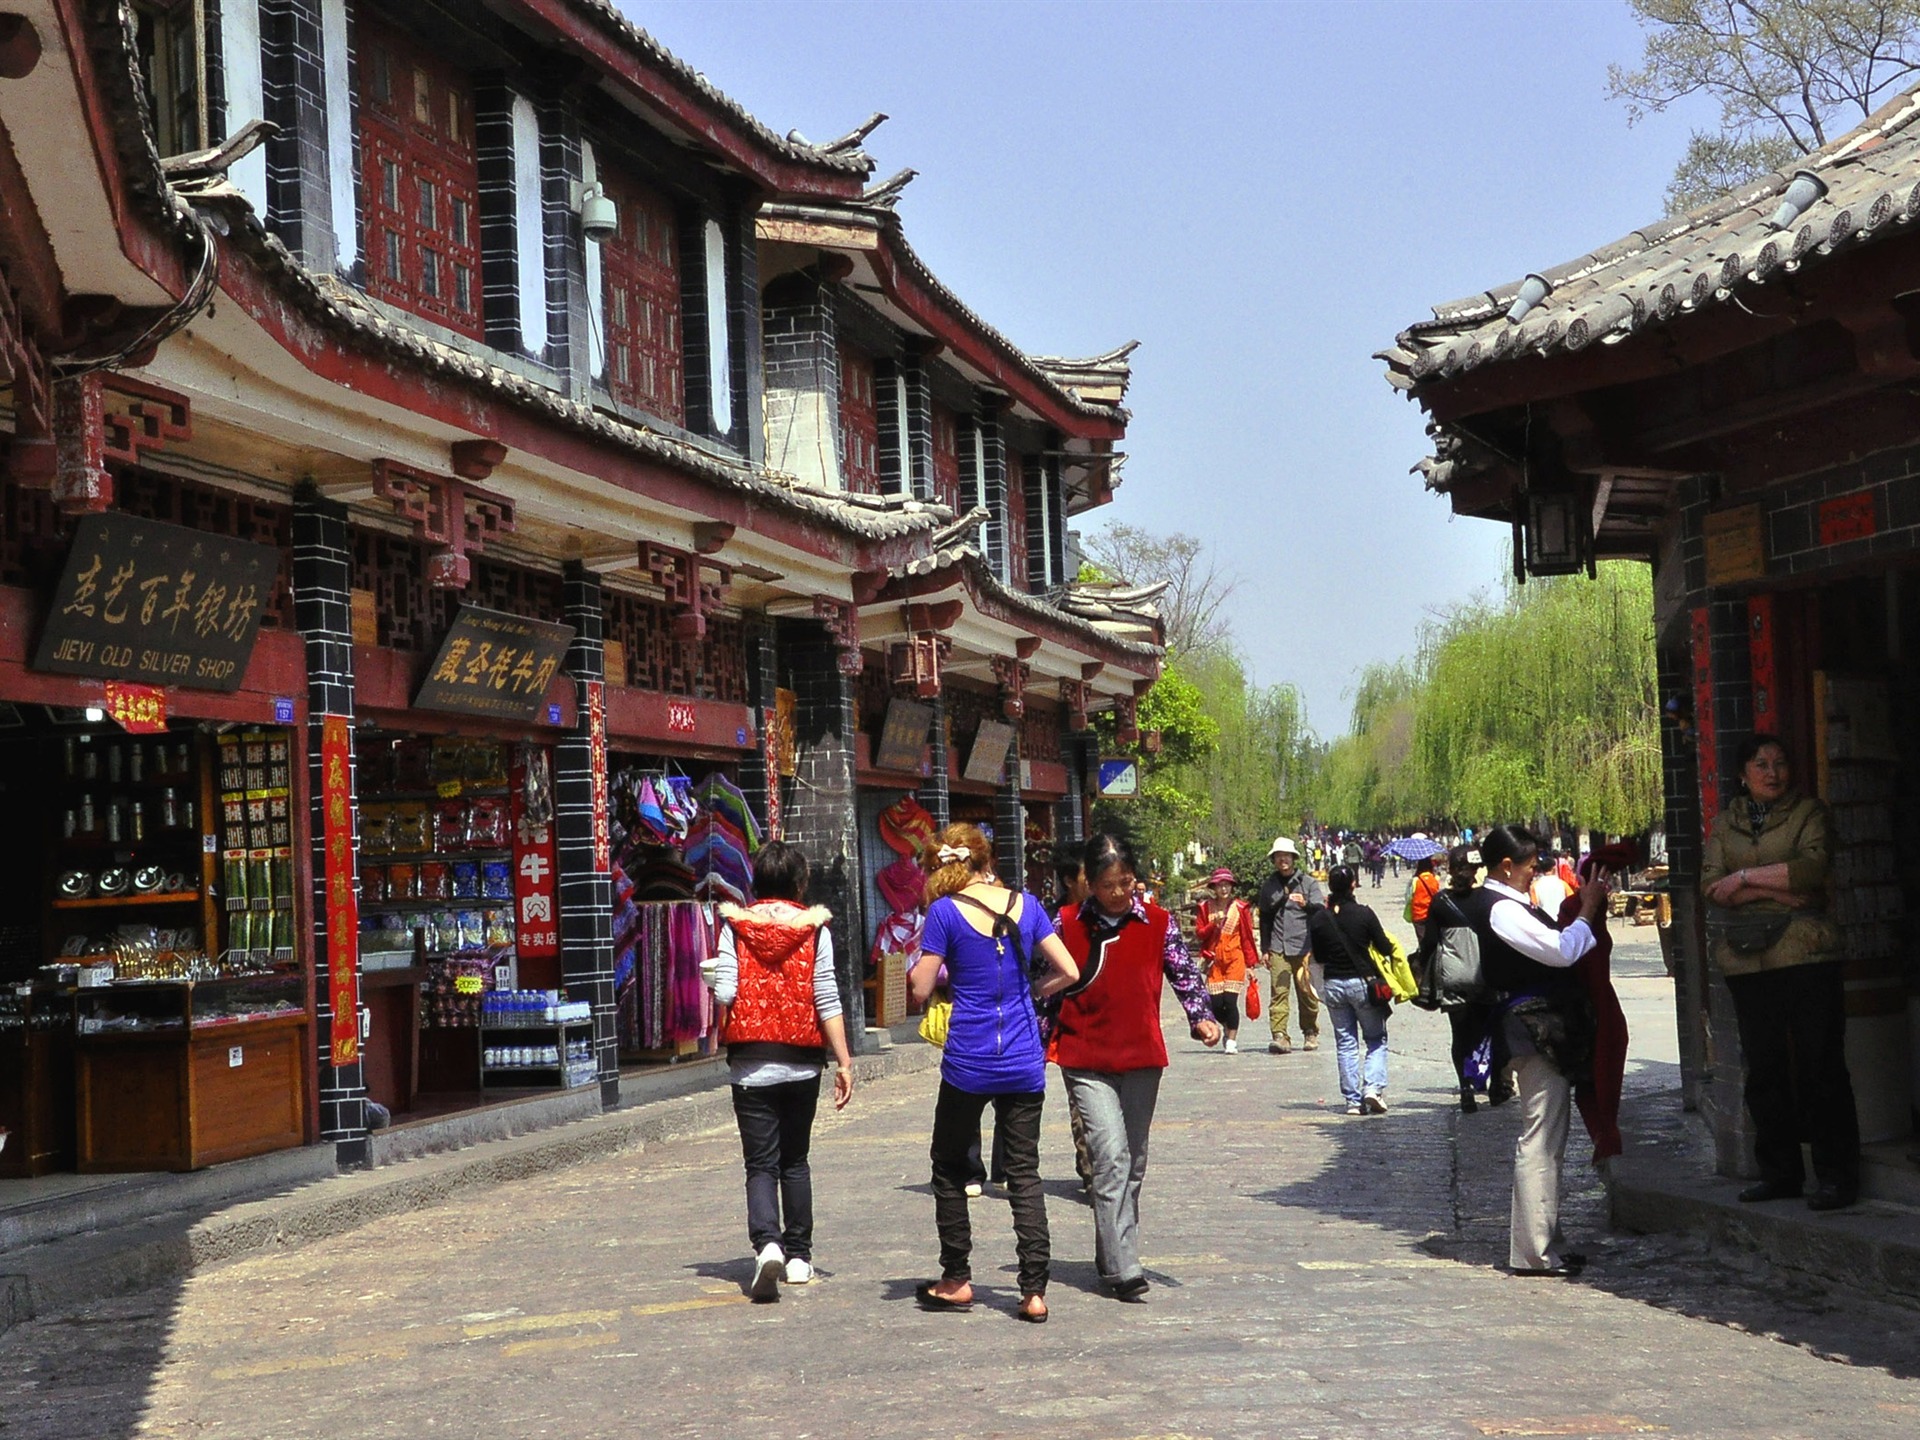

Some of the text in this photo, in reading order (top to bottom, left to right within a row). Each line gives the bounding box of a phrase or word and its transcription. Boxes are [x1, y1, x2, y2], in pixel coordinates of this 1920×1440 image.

[53, 638, 236, 680] JIEYI OLD SILVER SHOP
[519, 932, 557, 946] 专卖店
